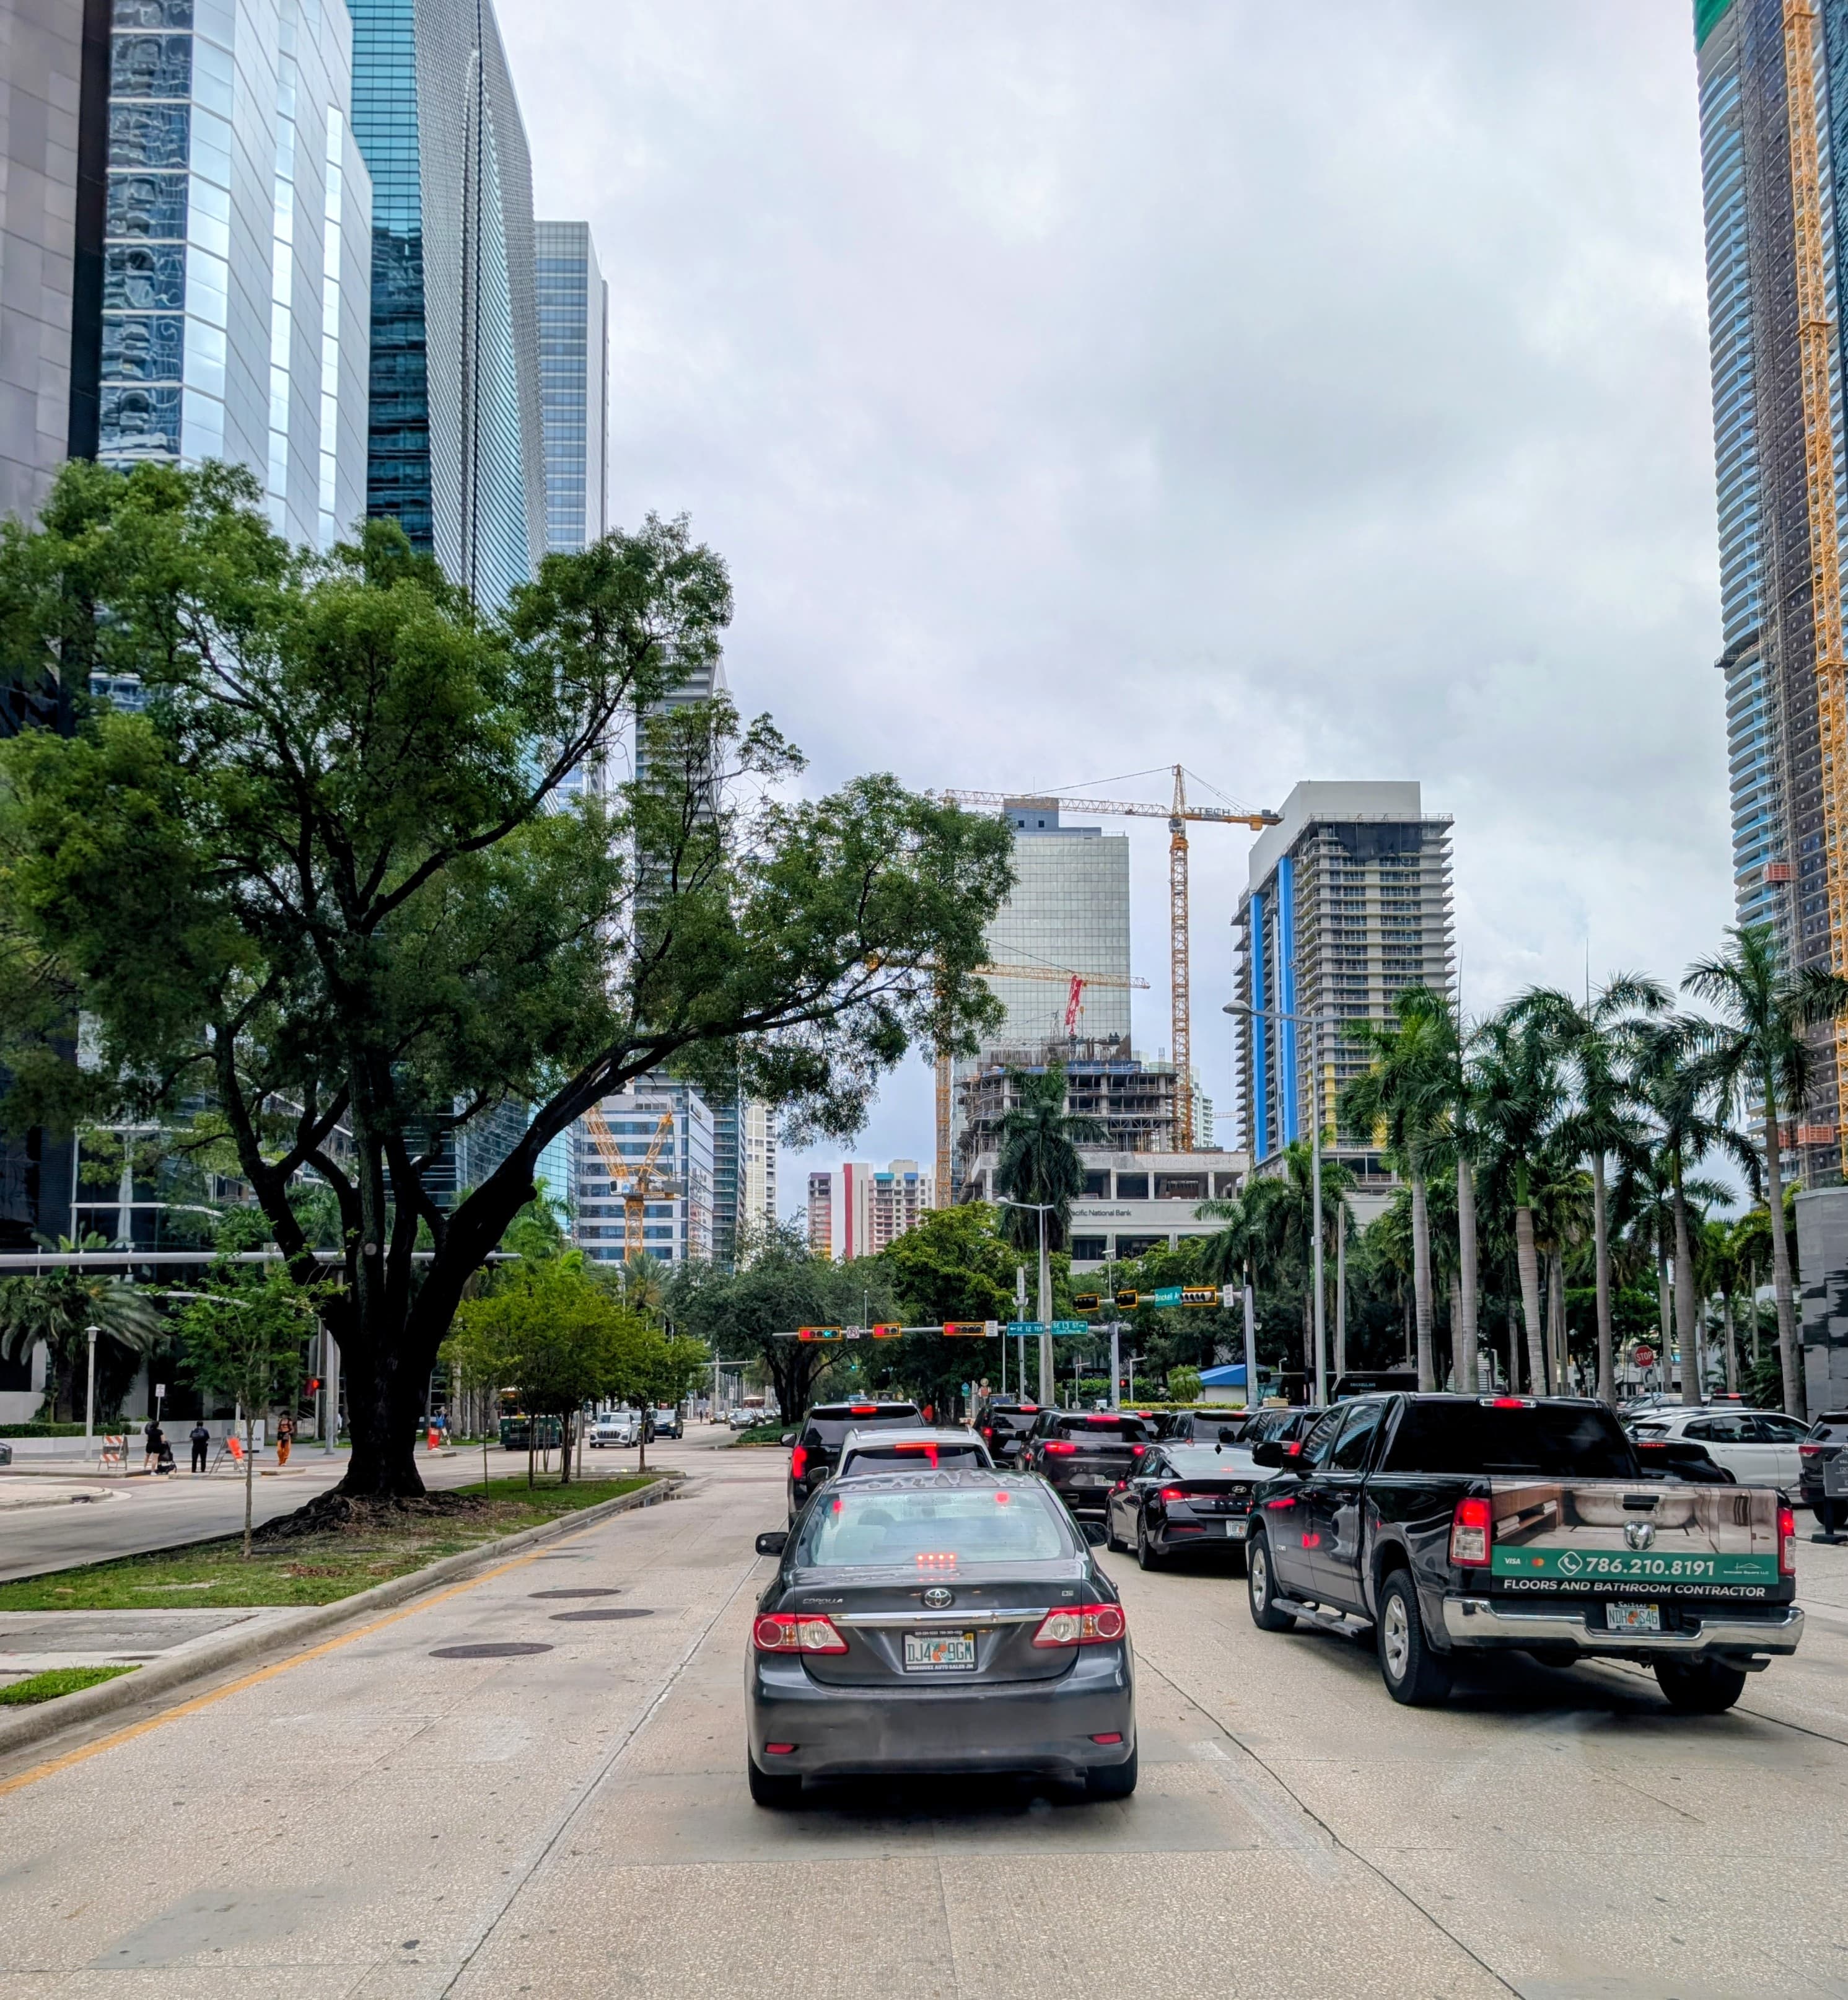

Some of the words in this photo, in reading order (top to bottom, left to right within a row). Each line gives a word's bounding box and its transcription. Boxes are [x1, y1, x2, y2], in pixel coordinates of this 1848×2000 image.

[1155, 1292, 1173, 1302] Brickell
[1062, 1322, 1069, 1330] 13
[1636, 1351, 1652, 1362] STOP
[1586, 1557, 1714, 1576] 786.210.8191
[1504, 1579, 1557, 1590] FLOORS
[1560, 1581, 1590, 1591] AND
[1593, 1582, 1671, 1594] BATHROOM
[1675, 1584, 1766, 1597] CONTRACTOR
